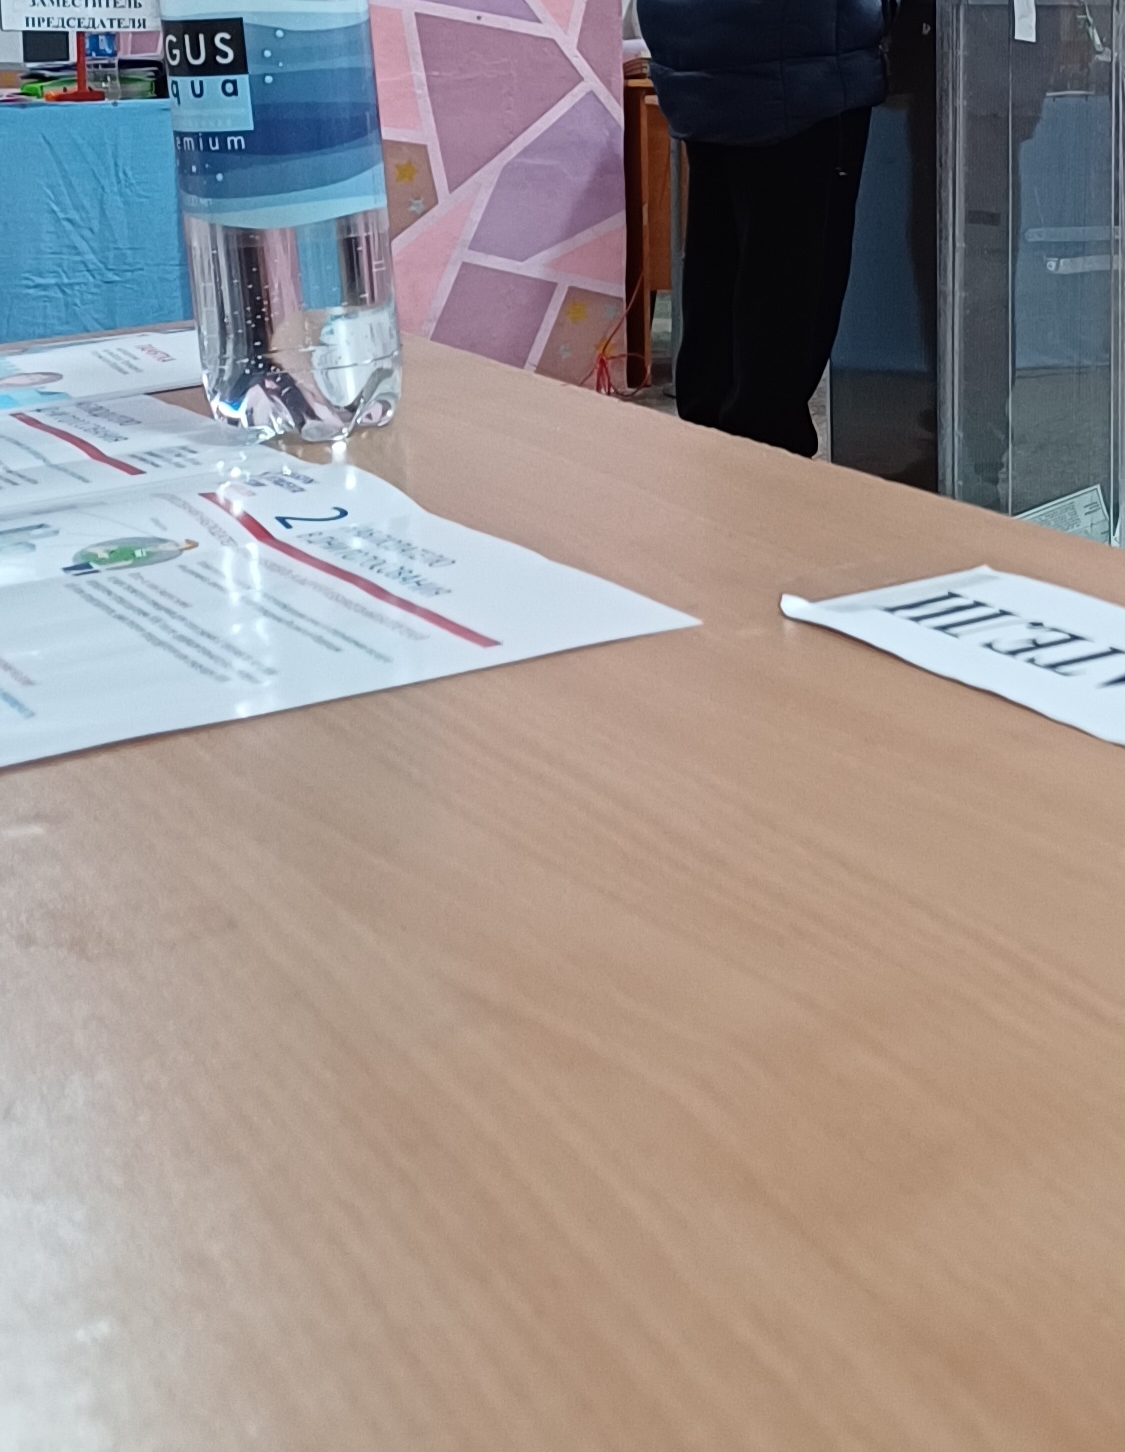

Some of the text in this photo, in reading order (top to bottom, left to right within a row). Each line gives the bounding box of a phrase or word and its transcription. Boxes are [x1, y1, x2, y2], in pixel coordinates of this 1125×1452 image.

[25, 16, 147, 30] ПРЕДСЕДАТЕЛЯ
[165, 32, 235, 66] GUS
[170, 78, 239, 106] qua
